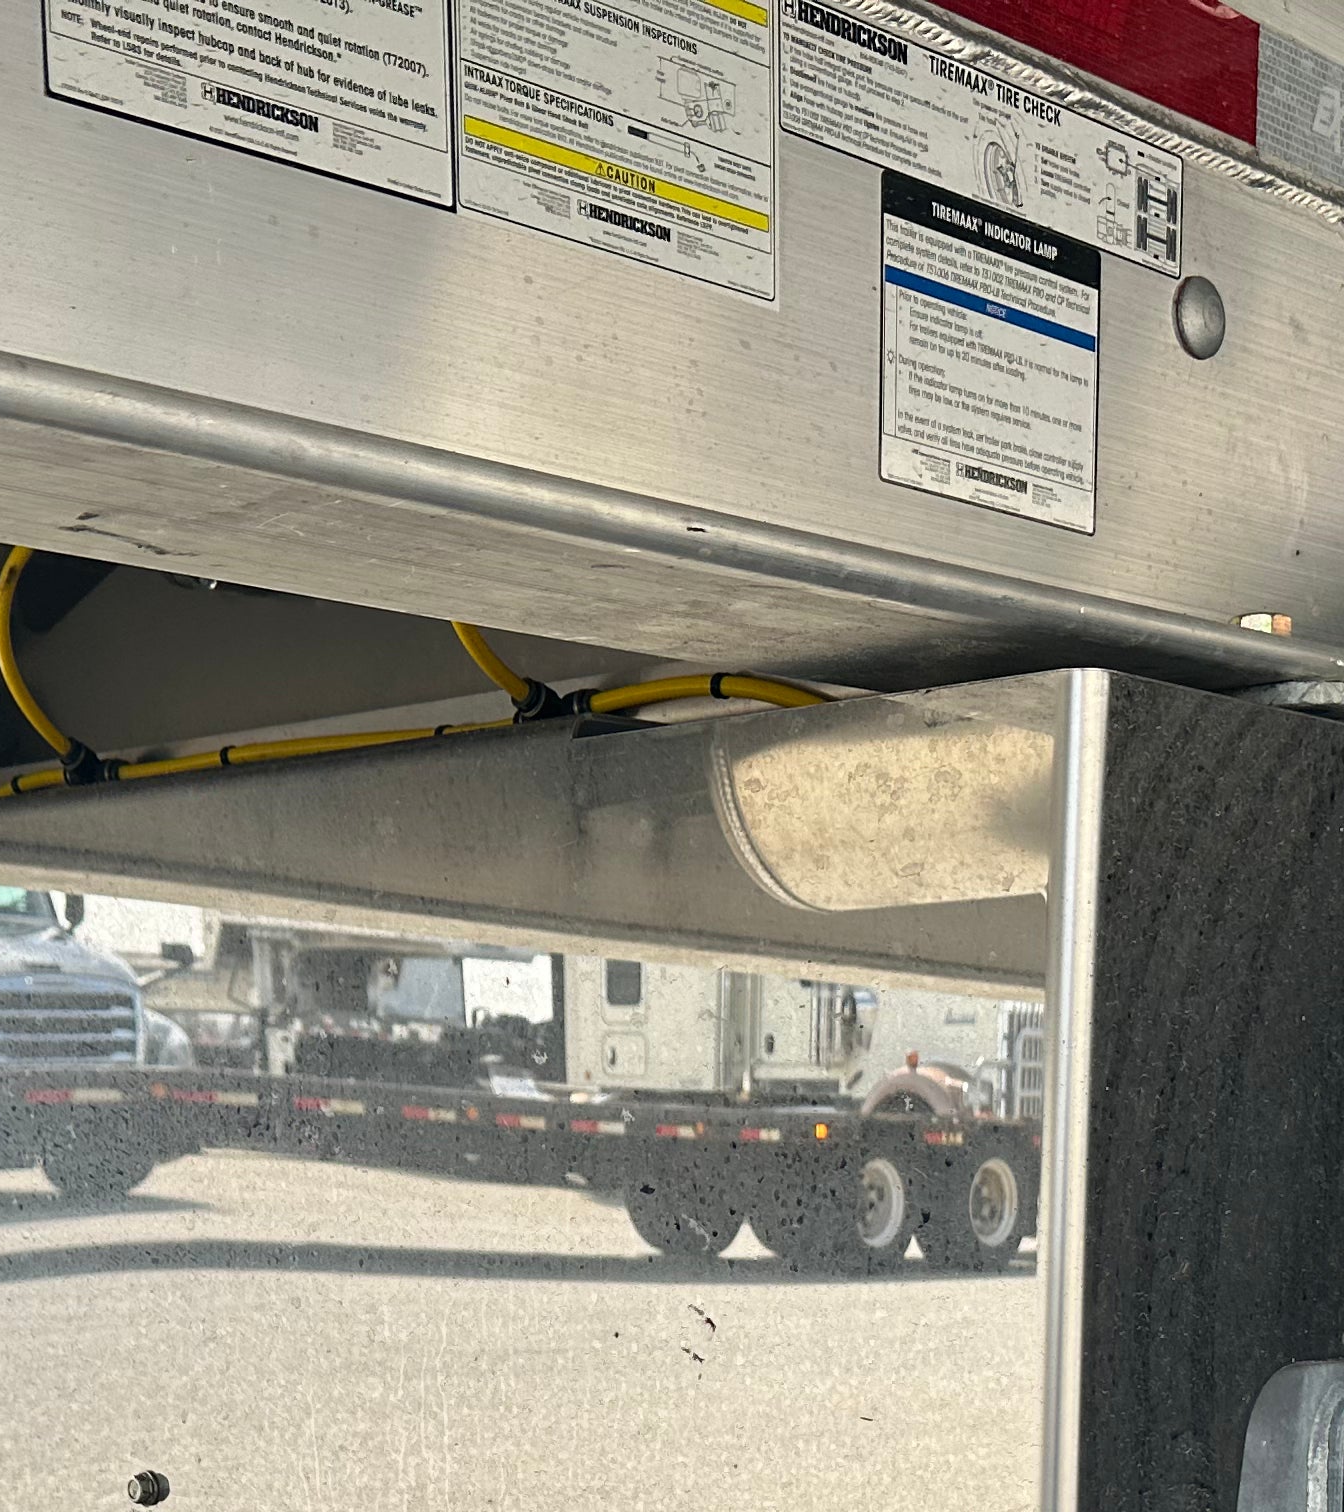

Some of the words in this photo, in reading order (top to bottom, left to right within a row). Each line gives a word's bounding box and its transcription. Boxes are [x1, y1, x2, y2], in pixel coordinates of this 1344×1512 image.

[61, 9, 83, 25] NOTE:
[162, 0, 189, 14] quiet
[192, 7, 234, 30] rotation,
[236, 22, 271, 41] contact
[584, 1, 639, 32] SUSPENSION
[642, 24, 697, 54] INSPECTIONS
[797, 0, 907, 64] HENDRICKSON
[221, 0, 255, 19] ensure
[258, 12, 293, 32] smooth
[296, 25, 314, 39] and
[317, 32, 341, 48] quiet
[344, 41, 379, 60] rotation
[382, 52, 429, 78] (T72007).
[114, 6, 154, 30] visually
[158, 18, 195, 40] inspect
[198, 31, 234, 54] hubcap
[237, 46, 255, 60] and
[259, 50, 281, 68] back
[283, 60, 294, 72] of
[296, 62, 314, 78] hub
[317, 68, 330, 83] for
[333, 77, 374, 97] evidence
[377, 89, 386, 101] of
[389, 92, 408, 108] lube
[411, 99, 437, 118] leaks.
[216, 87, 318, 132] HENDRICKSON
[464, 64, 503, 88] INTRAAX
[504, 78, 540, 101] TORQUE
[543, 92, 613, 126] SPECIFICATIONS
[996, 83, 1019, 109] TIRE
[1023, 95, 1060, 126] CHECK
[606, 166, 655, 192] CAUTION
[589, 203, 670, 241] HENDRICKSON
[984, 222, 1030, 250] INDICATOR
[1033, 240, 1057, 260] LAMP
[964, 465, 1027, 493] HENDRICKSON
